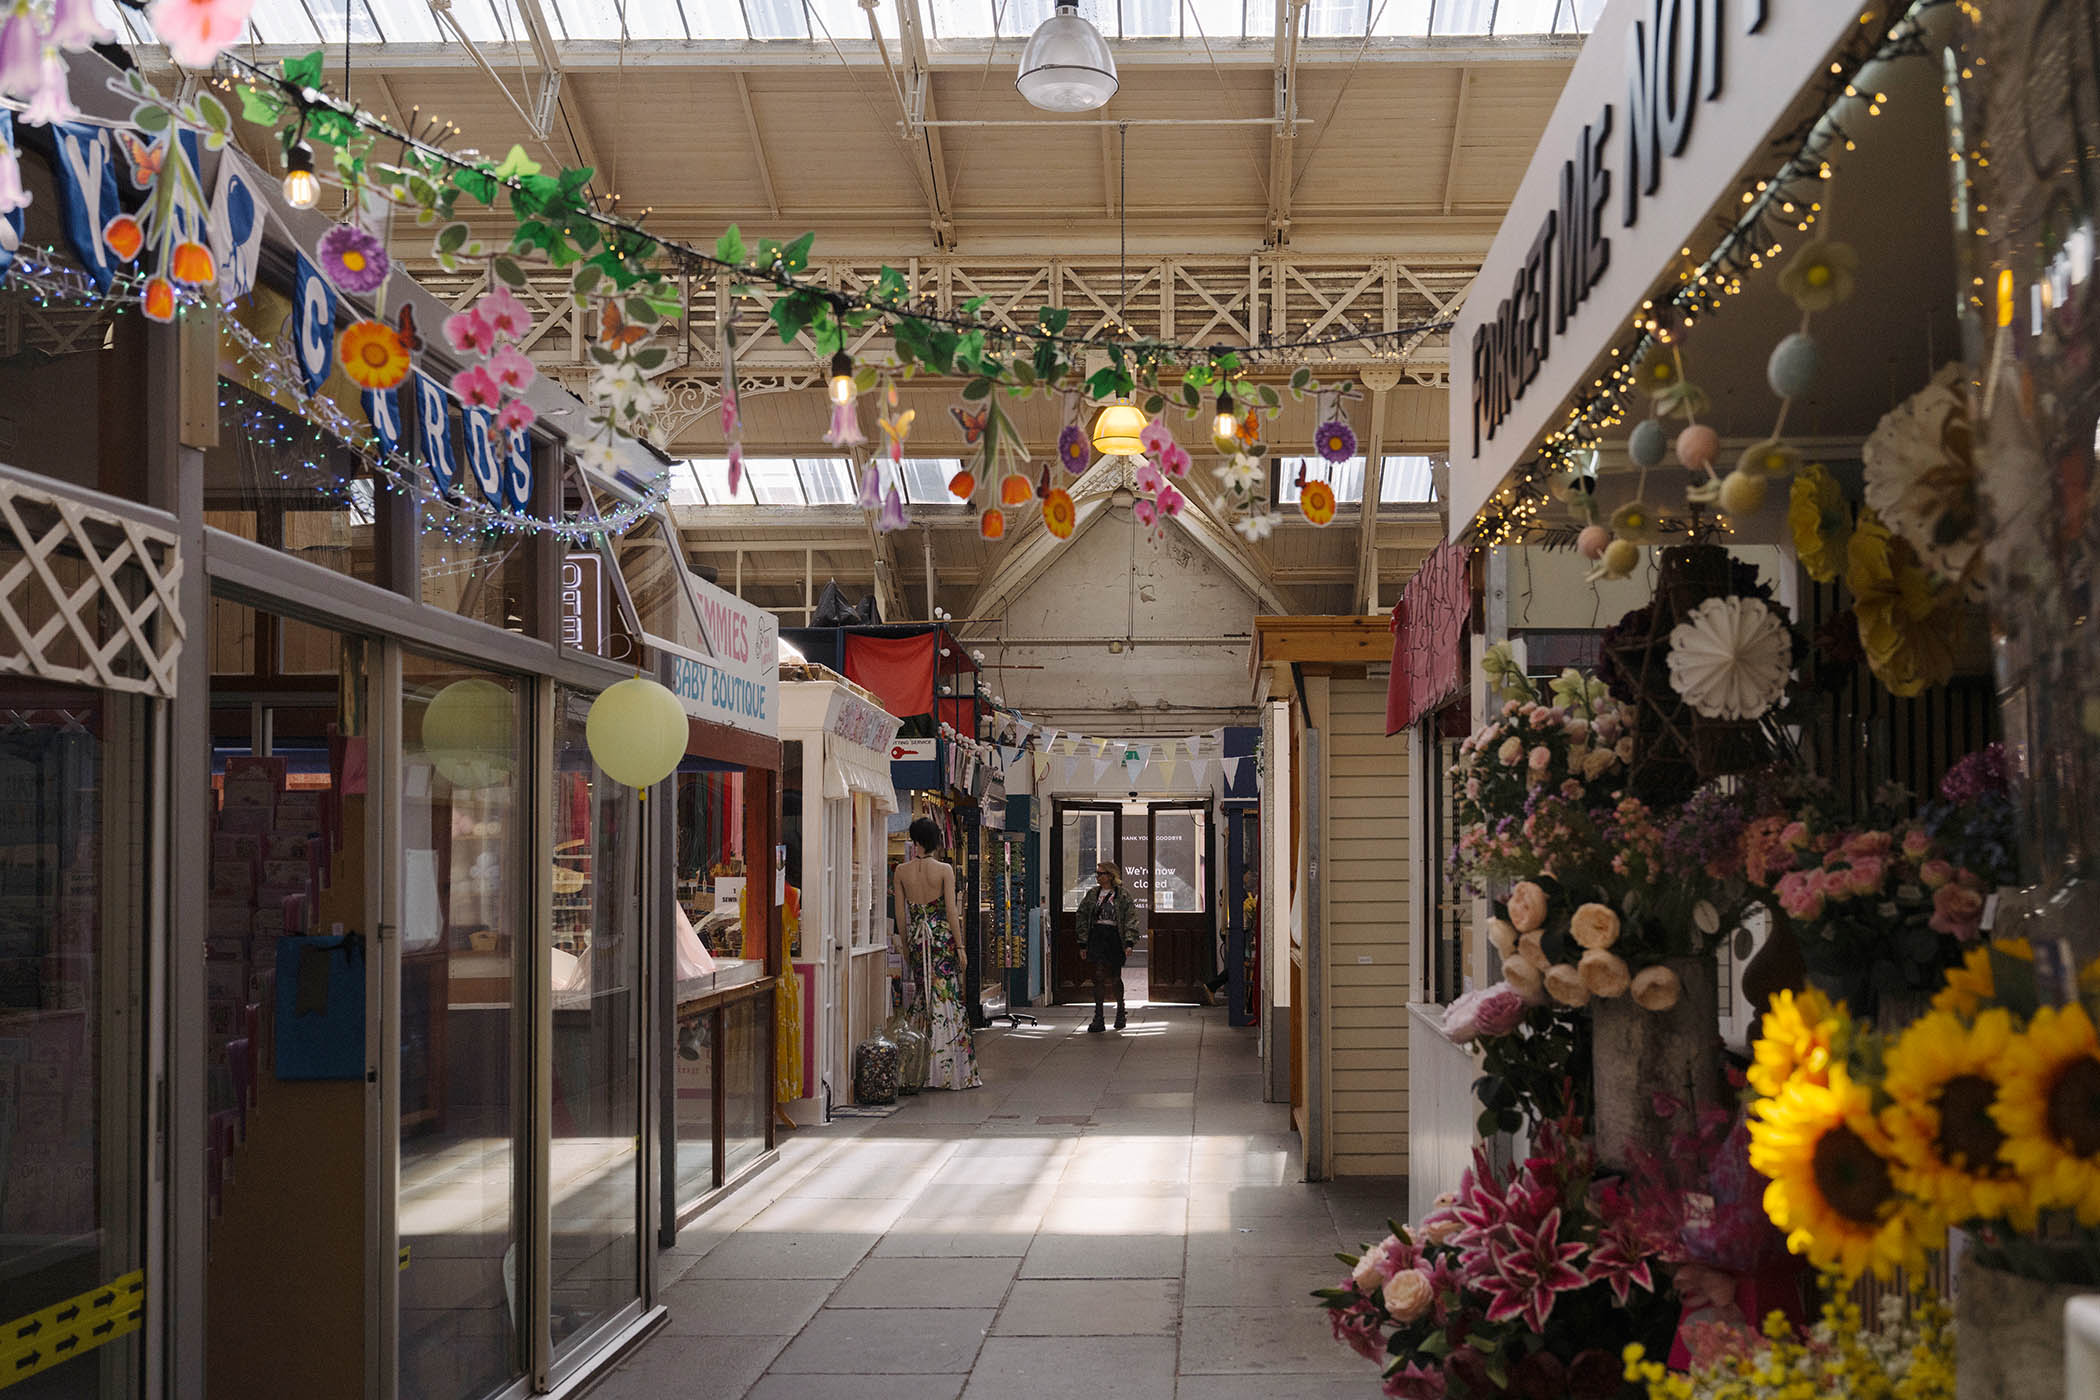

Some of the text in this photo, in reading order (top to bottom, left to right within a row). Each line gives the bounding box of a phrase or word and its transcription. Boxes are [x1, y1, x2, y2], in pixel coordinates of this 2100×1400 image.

[1473, 210, 1556, 458] FORGET
[1556, 104, 1613, 334] ME
[697, 592, 749, 665] MMIES
[674, 658, 766, 720] BABY BOUTIQUE
[1133, 879, 1167, 889] cloed
[1155, 868, 1176, 876] now
